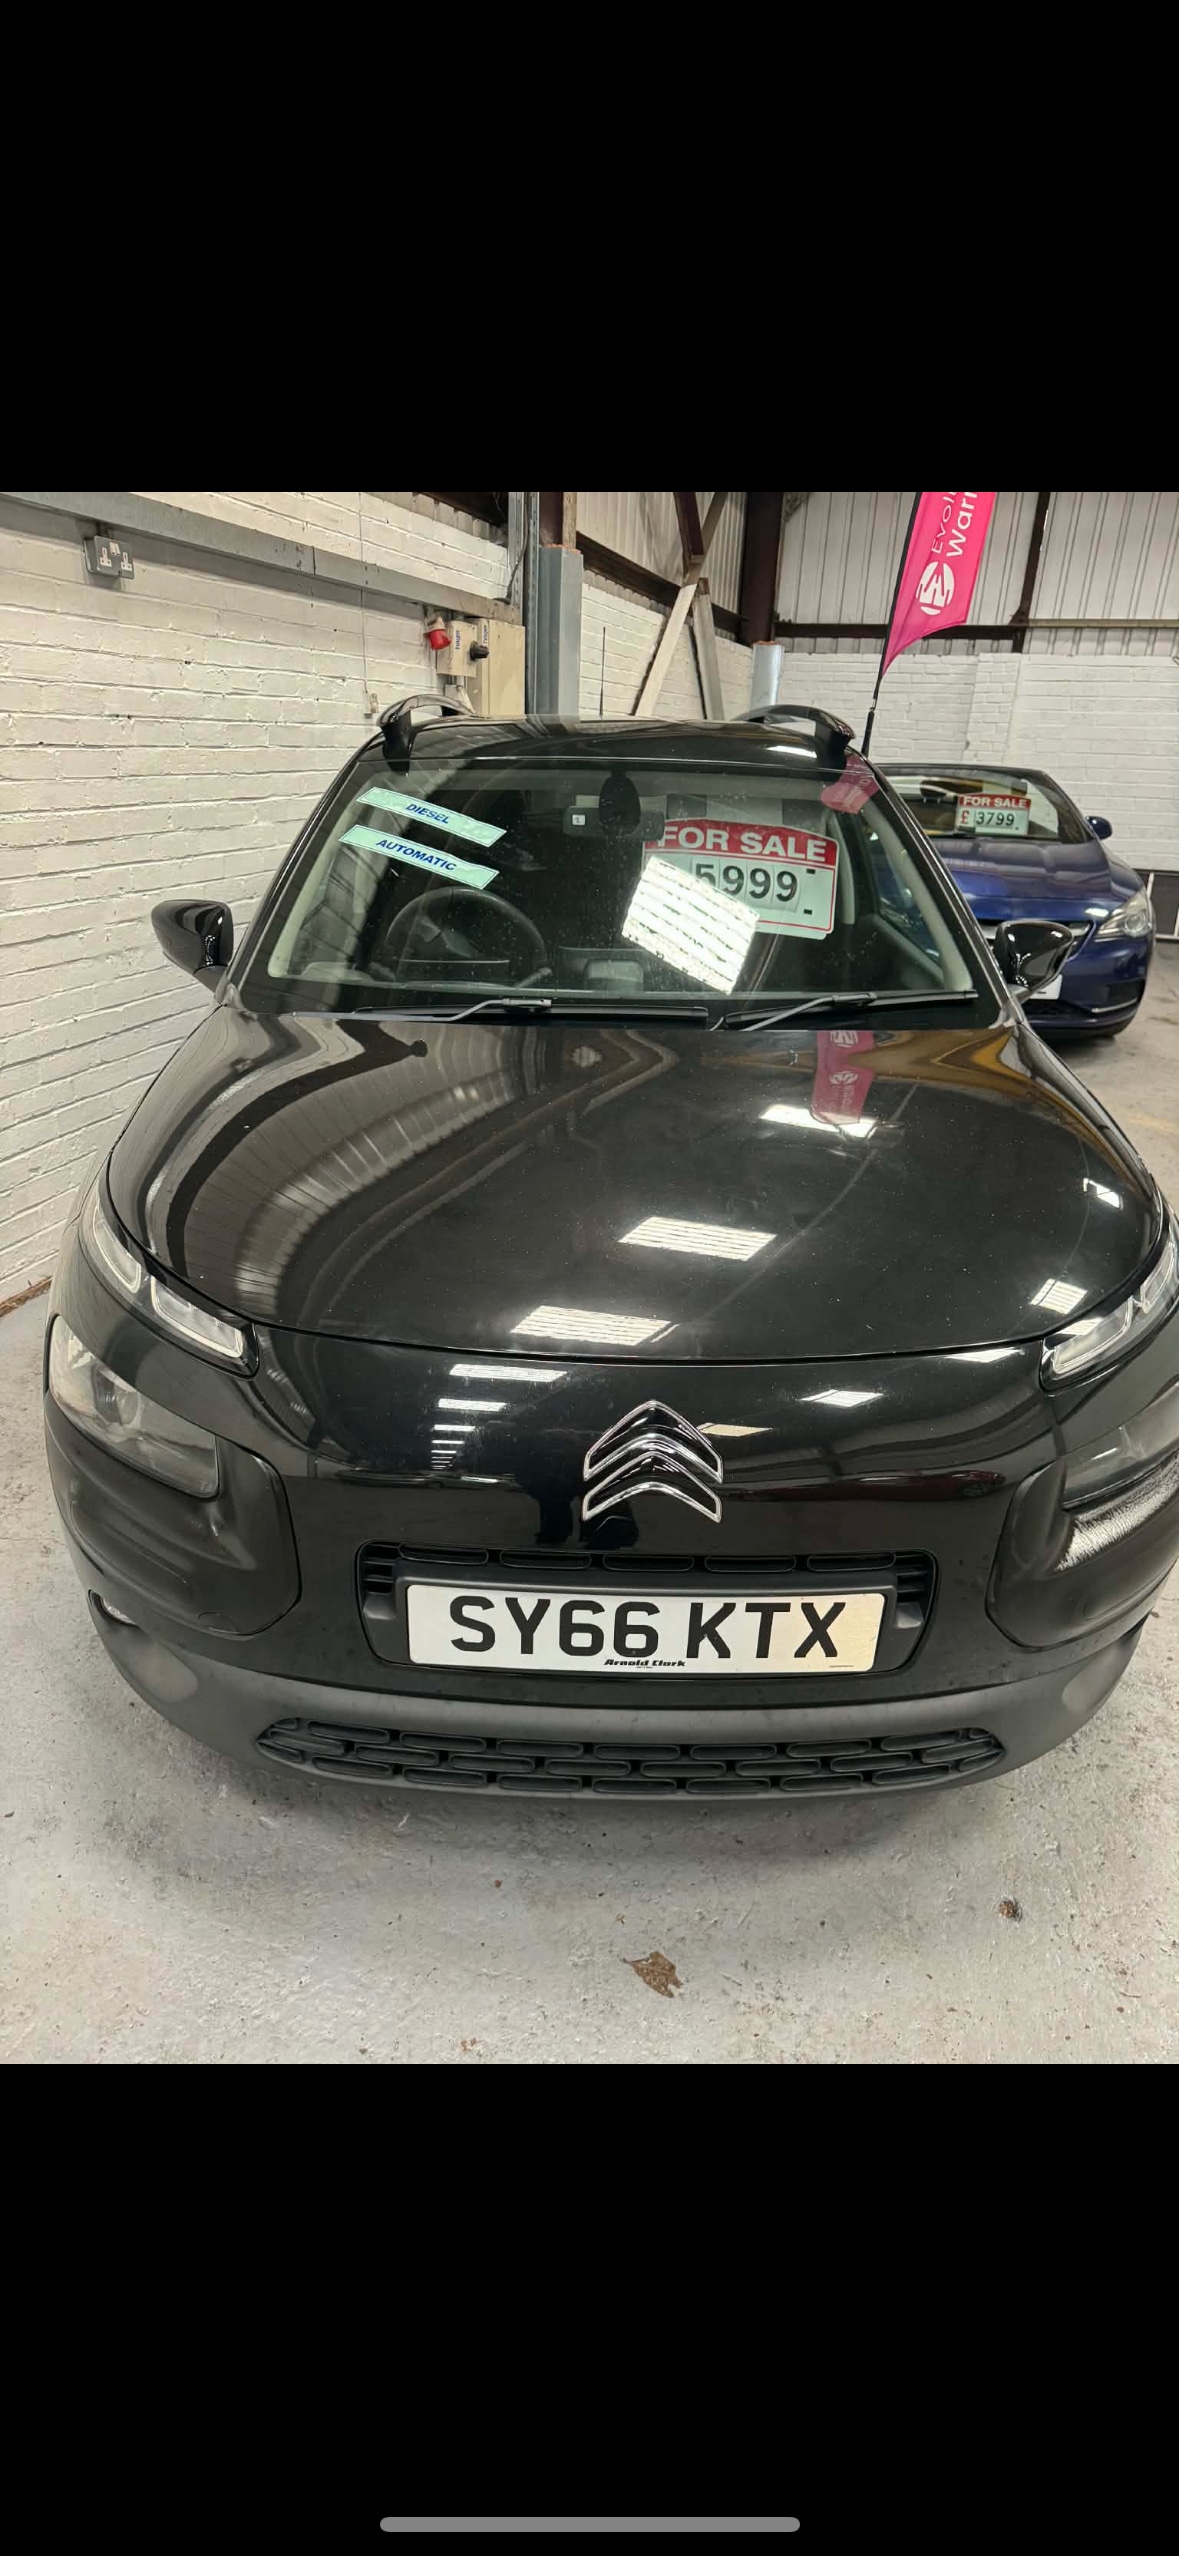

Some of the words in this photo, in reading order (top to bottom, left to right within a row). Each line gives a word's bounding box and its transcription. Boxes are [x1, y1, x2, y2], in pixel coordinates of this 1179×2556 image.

[405, 803, 450, 825] DIESEL
[963, 796, 991, 807] FOR
[994, 797, 1027, 809] SALE
[960, 810, 970, 825] £
[976, 811, 1015, 826] 3799
[375, 839, 457, 871] AUTOMATIC
[657, 826, 730, 851] FOR
[740, 832, 827, 863] SALE
[449, 1595, 661, 1658] SY66
[686, 1601, 847, 1659] KTX
